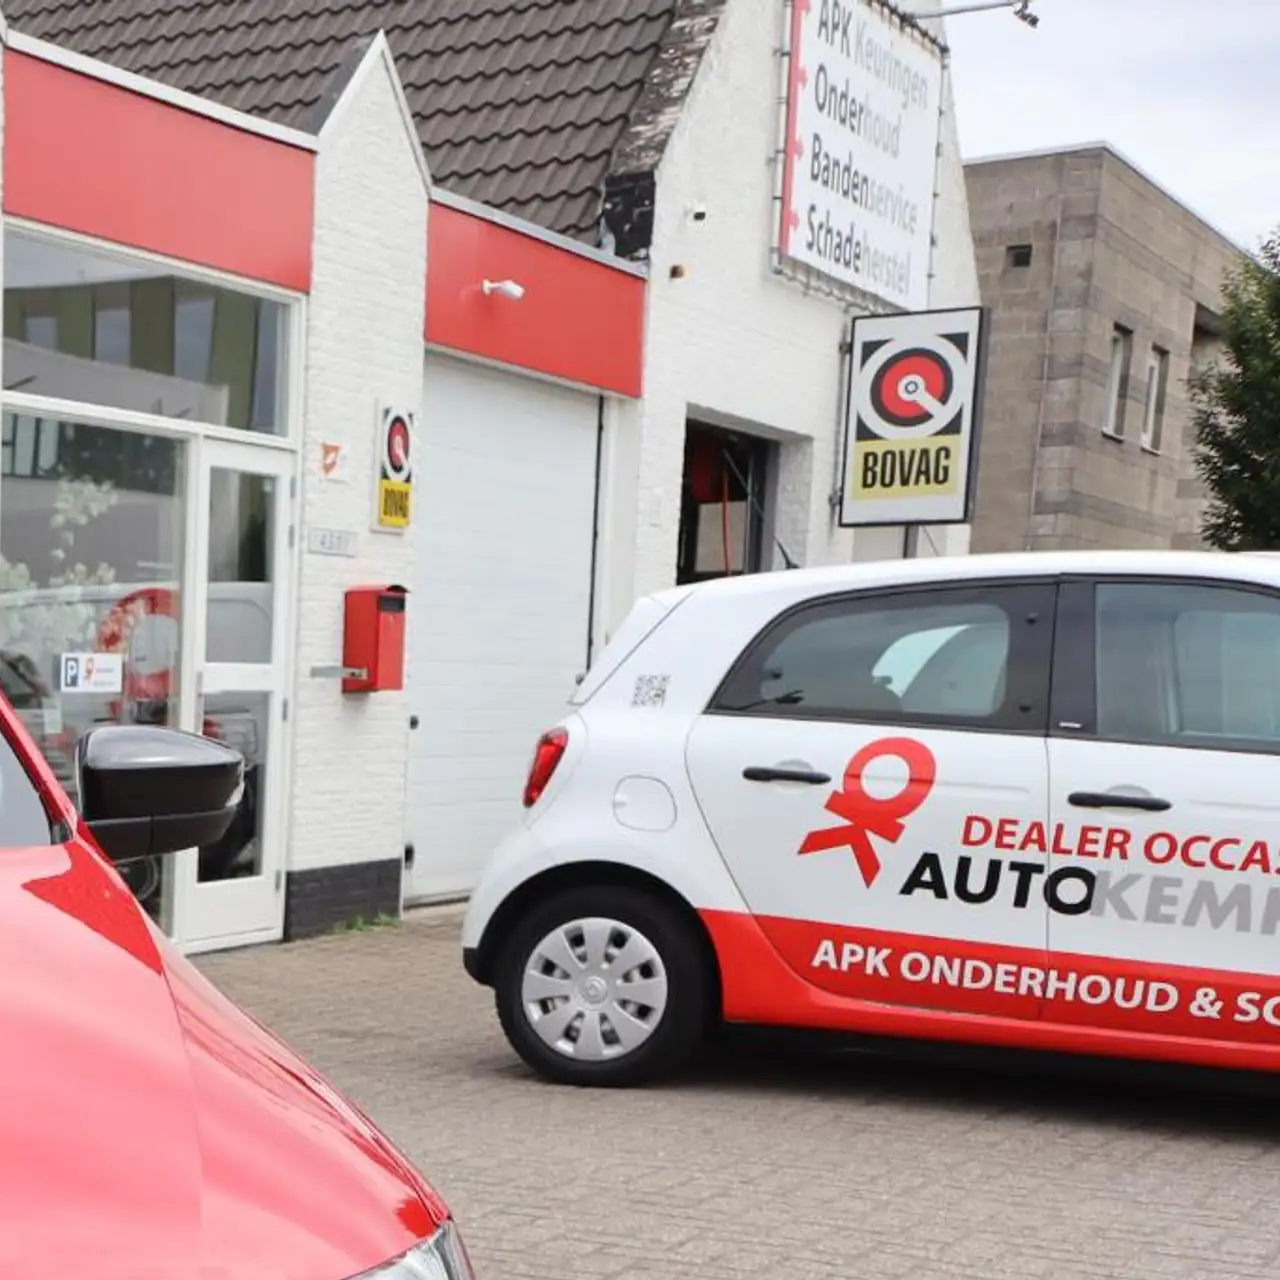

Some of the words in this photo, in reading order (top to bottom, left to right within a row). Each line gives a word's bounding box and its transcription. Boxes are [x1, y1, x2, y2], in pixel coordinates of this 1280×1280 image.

[817, 0, 852, 58] APK
[854, 18, 928, 110] Keuringen
[814, 63, 902, 158] Onderhoud
[810, 131, 918, 236] Bandenservice
[805, 203, 912, 297] Schadeherstel
[861, 446, 951, 489] BOVAG
[961, 815, 1132, 861] DEALER
[1143, 832, 1280, 875] OCCA
[811, 939, 891, 977] APK
[900, 951, 1179, 1013] ONDERHOUD
[1188, 987, 1223, 1019] &
